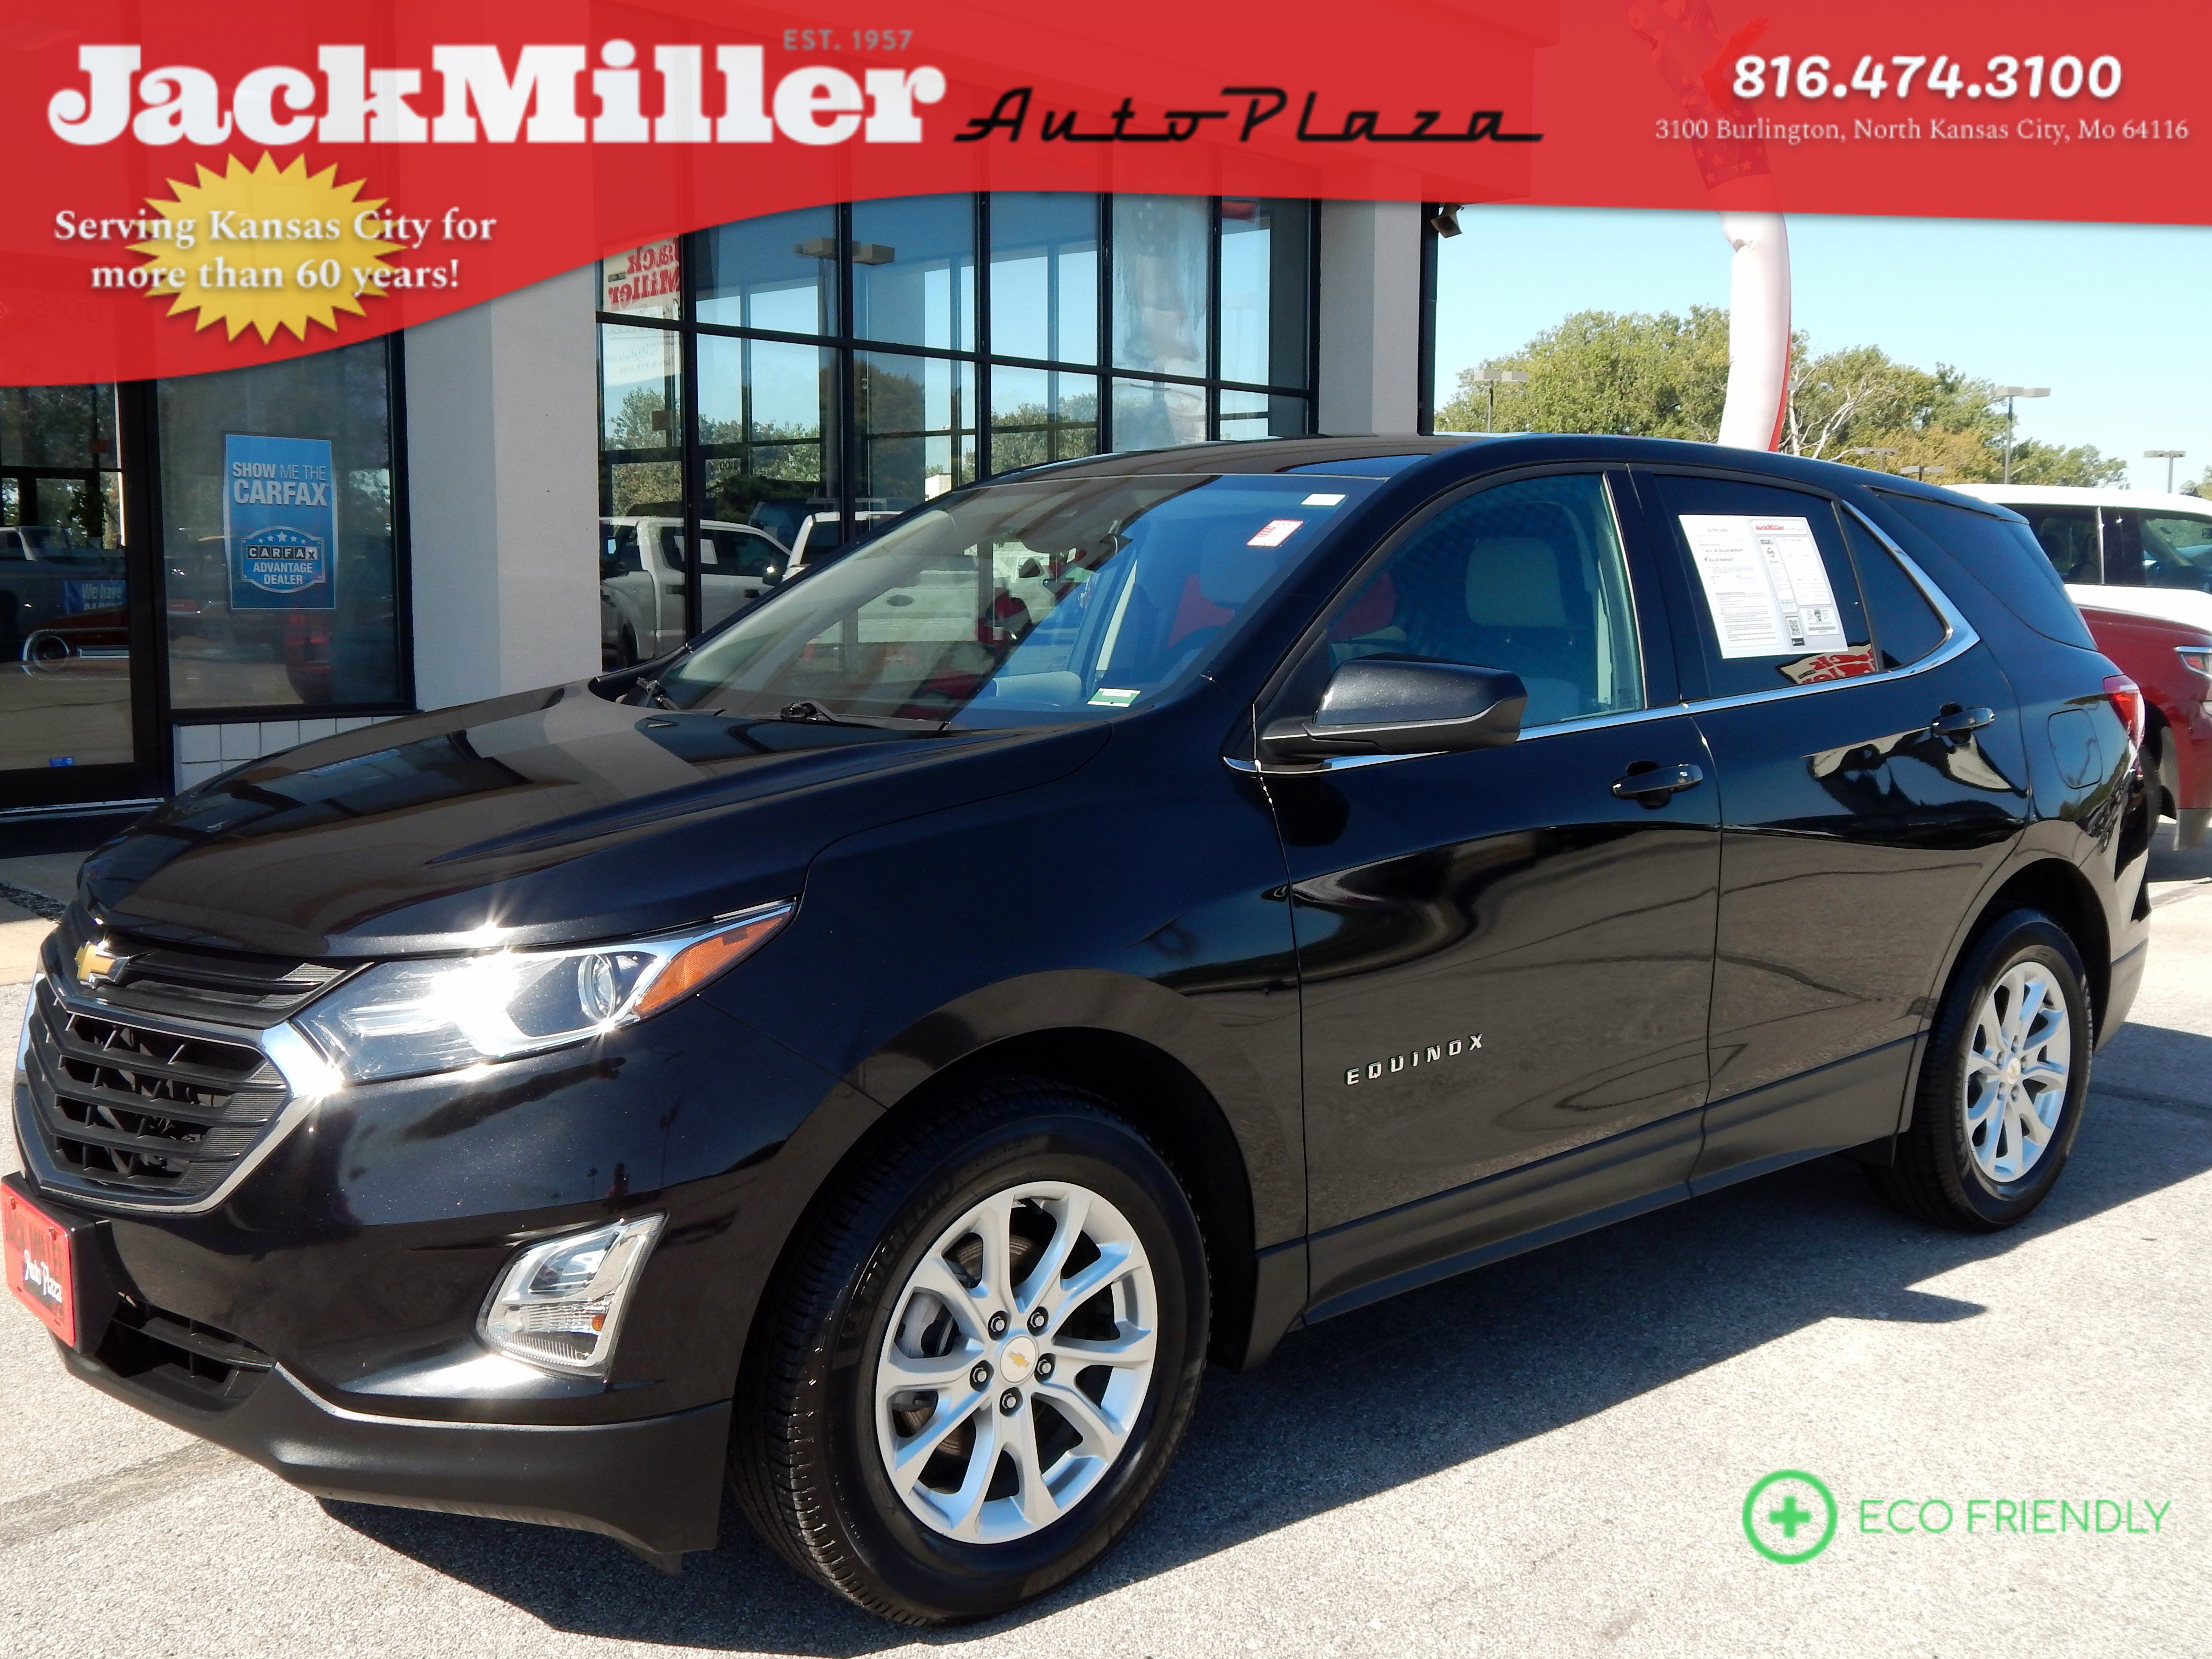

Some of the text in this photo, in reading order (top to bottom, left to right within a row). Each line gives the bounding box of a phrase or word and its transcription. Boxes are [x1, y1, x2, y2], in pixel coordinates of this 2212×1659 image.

[232, 461, 327, 481] SHOW ME THE
[233, 479, 327, 506] CARFAX
[248, 546, 318, 560] CARFAX
[253, 562, 313, 573] ADVANTAGE
[264, 574, 303, 585] DEALER
[81, 583, 122, 600] We have
[1345, 1033, 1483, 1085] EQUINOX
